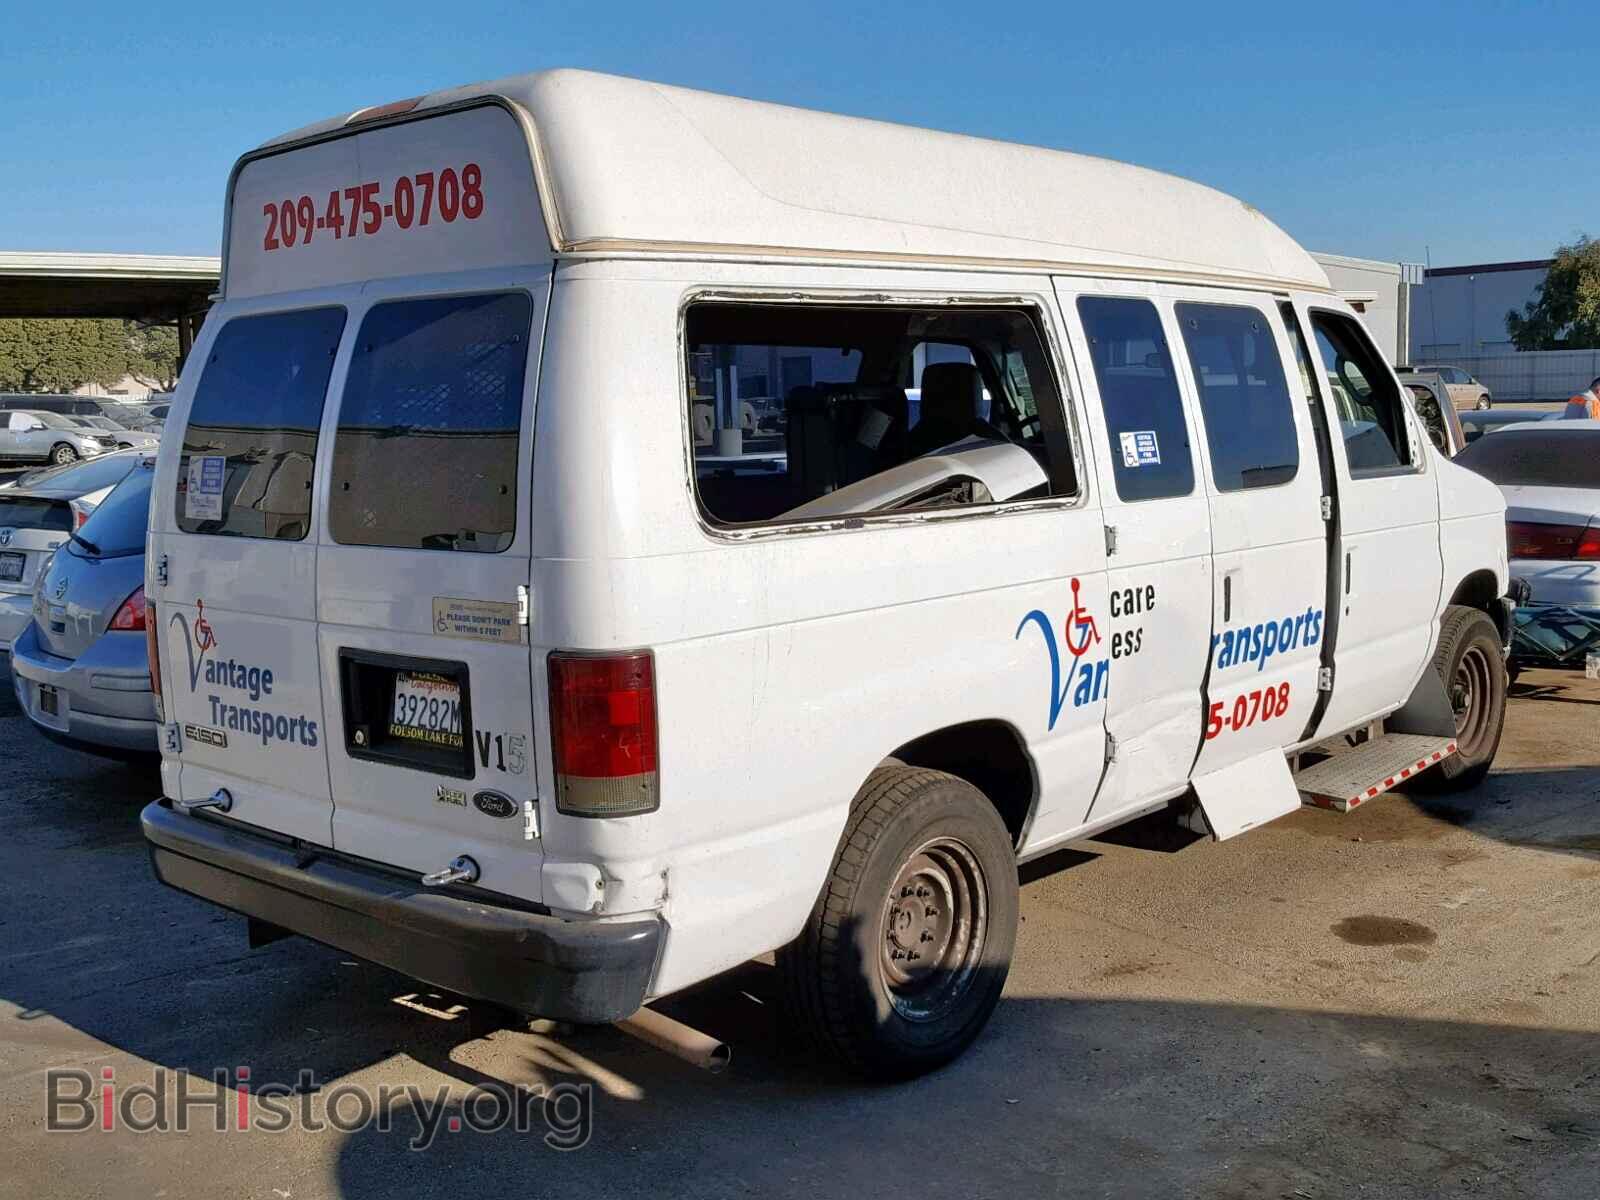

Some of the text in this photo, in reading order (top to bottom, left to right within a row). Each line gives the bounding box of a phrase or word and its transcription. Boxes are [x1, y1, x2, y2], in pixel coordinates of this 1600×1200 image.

[264, 163, 484, 250] 209-475-0708
[1110, 585, 1155, 618] care
[170, 612, 274, 701] Vantage
[1112, 627, 1143, 659] ess
[208, 695, 318, 746] Transports
[390, 724, 424, 742] FOLSOM
[480, 794, 505, 813] Ford
